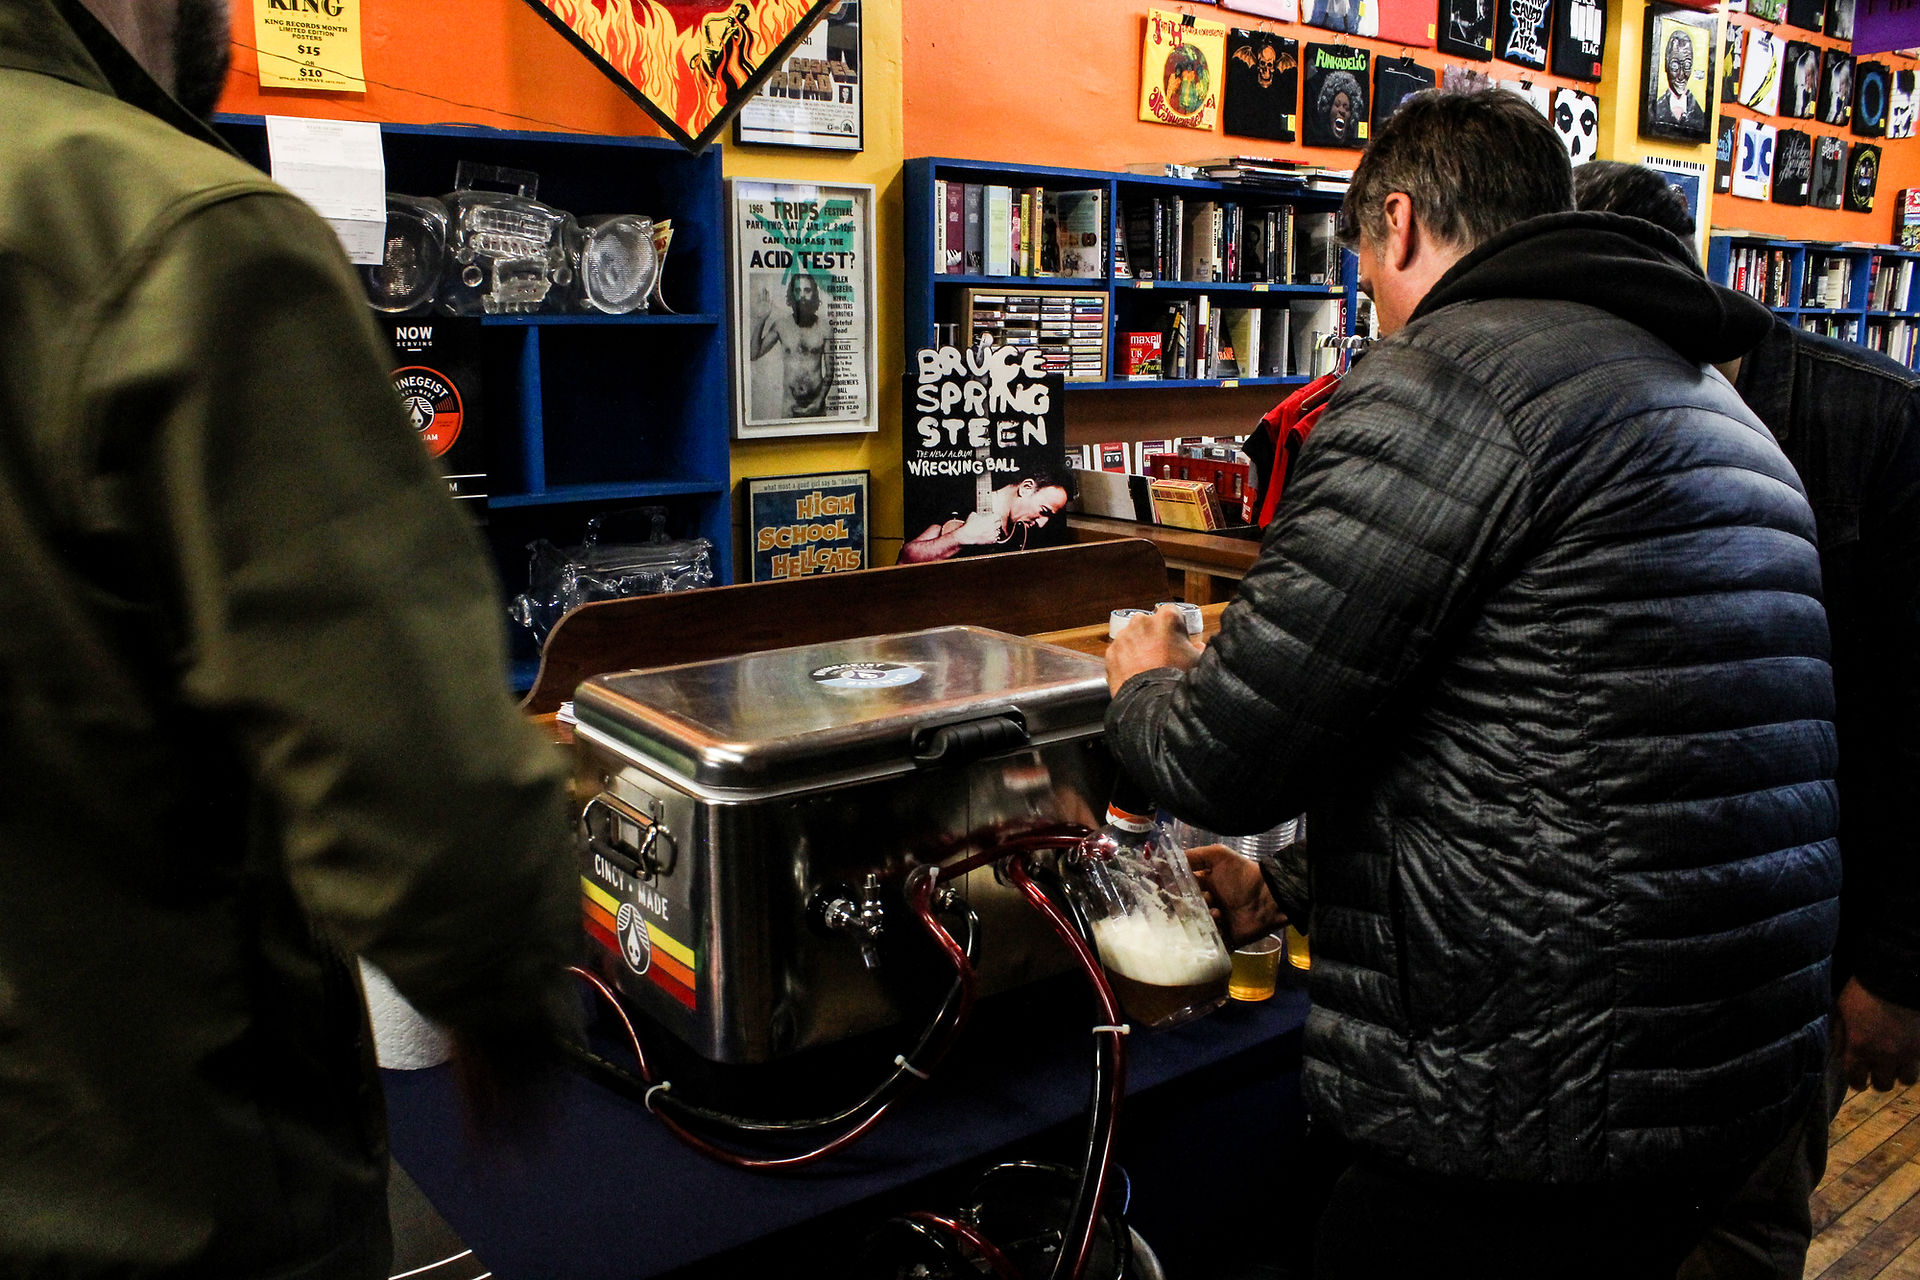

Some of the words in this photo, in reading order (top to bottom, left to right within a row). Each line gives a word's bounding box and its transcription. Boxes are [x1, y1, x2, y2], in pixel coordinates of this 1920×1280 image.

[1511, 1, 1543, 24] SAVED
[265, 18, 284, 26] KING
[286, 21, 320, 30] RECORDS
[322, 24, 347, 33] MONTH
[279, 26, 306, 34] LIMITED
[307, 29, 335, 37] EDITION
[1517, 17, 1533, 35] MY
[292, 33, 322, 41] POSTERS
[1509, 31, 1537, 54] LIFE
[297, 44, 321, 56] $15
[1581, 41, 1600, 56] FLAG
[1315, 48, 1367, 71] FUNKADELIC
[299, 67, 322, 78] $10
[789, 57, 857, 84] GOSPEL
[769, 71, 833, 101] ROAD
[748, 204, 764, 214] 1966
[770, 201, 819, 221] TRIPS
[824, 207, 854, 217] FESTIVAL
[746, 220, 764, 230] PART
[762, 236, 780, 244] CAN
[784, 237, 802, 245] YOU
[750, 250, 793, 268] ACID
[798, 252, 856, 269] TEST?
[395, 326, 433, 340] NOW
[1130, 334, 1162, 344] maxell
[1131, 350, 1143, 358] UR
[917, 345, 1047, 384] BRUCE
[916, 380, 1050, 416] SPRING
[917, 415, 1048, 448] STEEN
[916, 449, 929, 458] THE
[929, 449, 948, 458] NEW
[948, 449, 973, 458] ALBUM
[907, 458, 984, 477] WRECKING
[985, 457, 1020, 473] BALL
[796, 491, 856, 520] HIGH
[757, 518, 849, 552] SCHOOL
[771, 545, 862, 579] HELLCATS
[594, 854, 624, 891] CINCY
[637, 884, 669, 922] MADE
